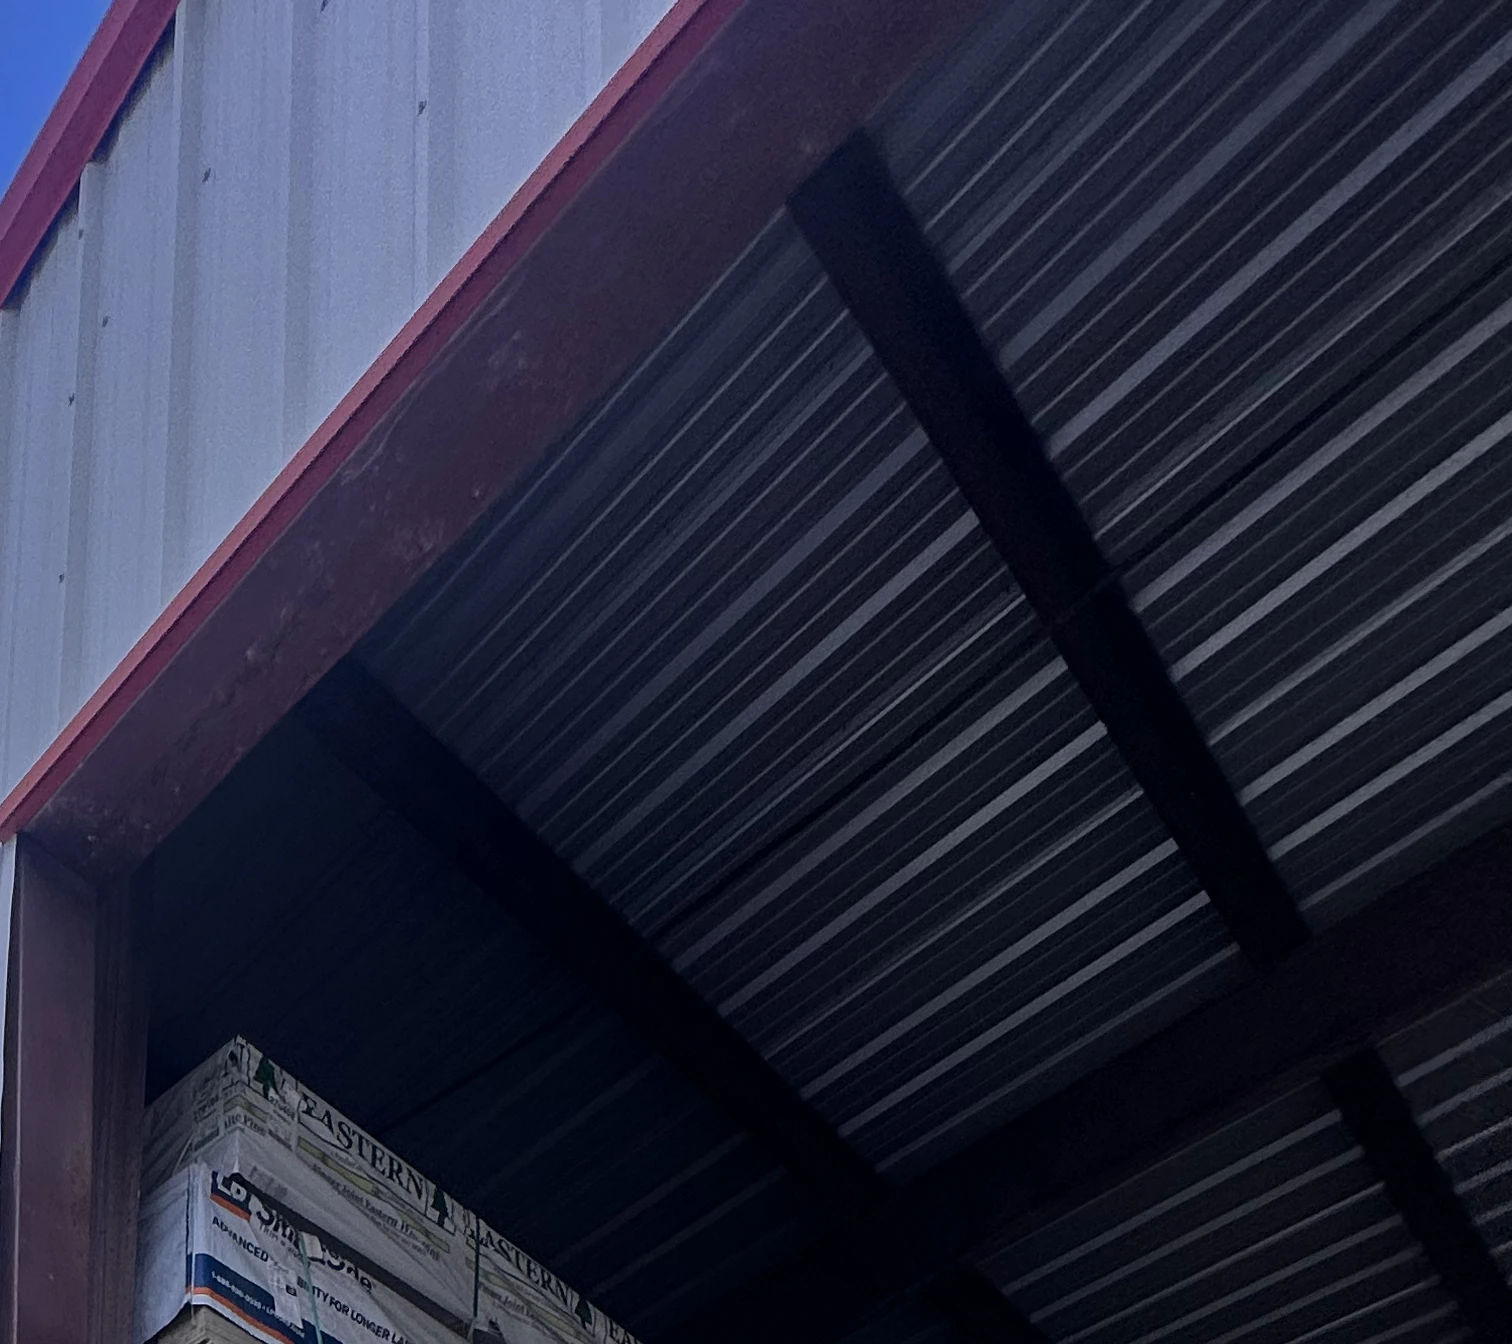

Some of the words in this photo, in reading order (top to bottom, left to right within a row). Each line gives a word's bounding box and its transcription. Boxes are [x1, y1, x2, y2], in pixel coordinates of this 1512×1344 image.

[301, 1093, 426, 1201] EASTERN
[329, 1294, 350, 1317] FOR
[349, 1308, 390, 1341] LONGER
